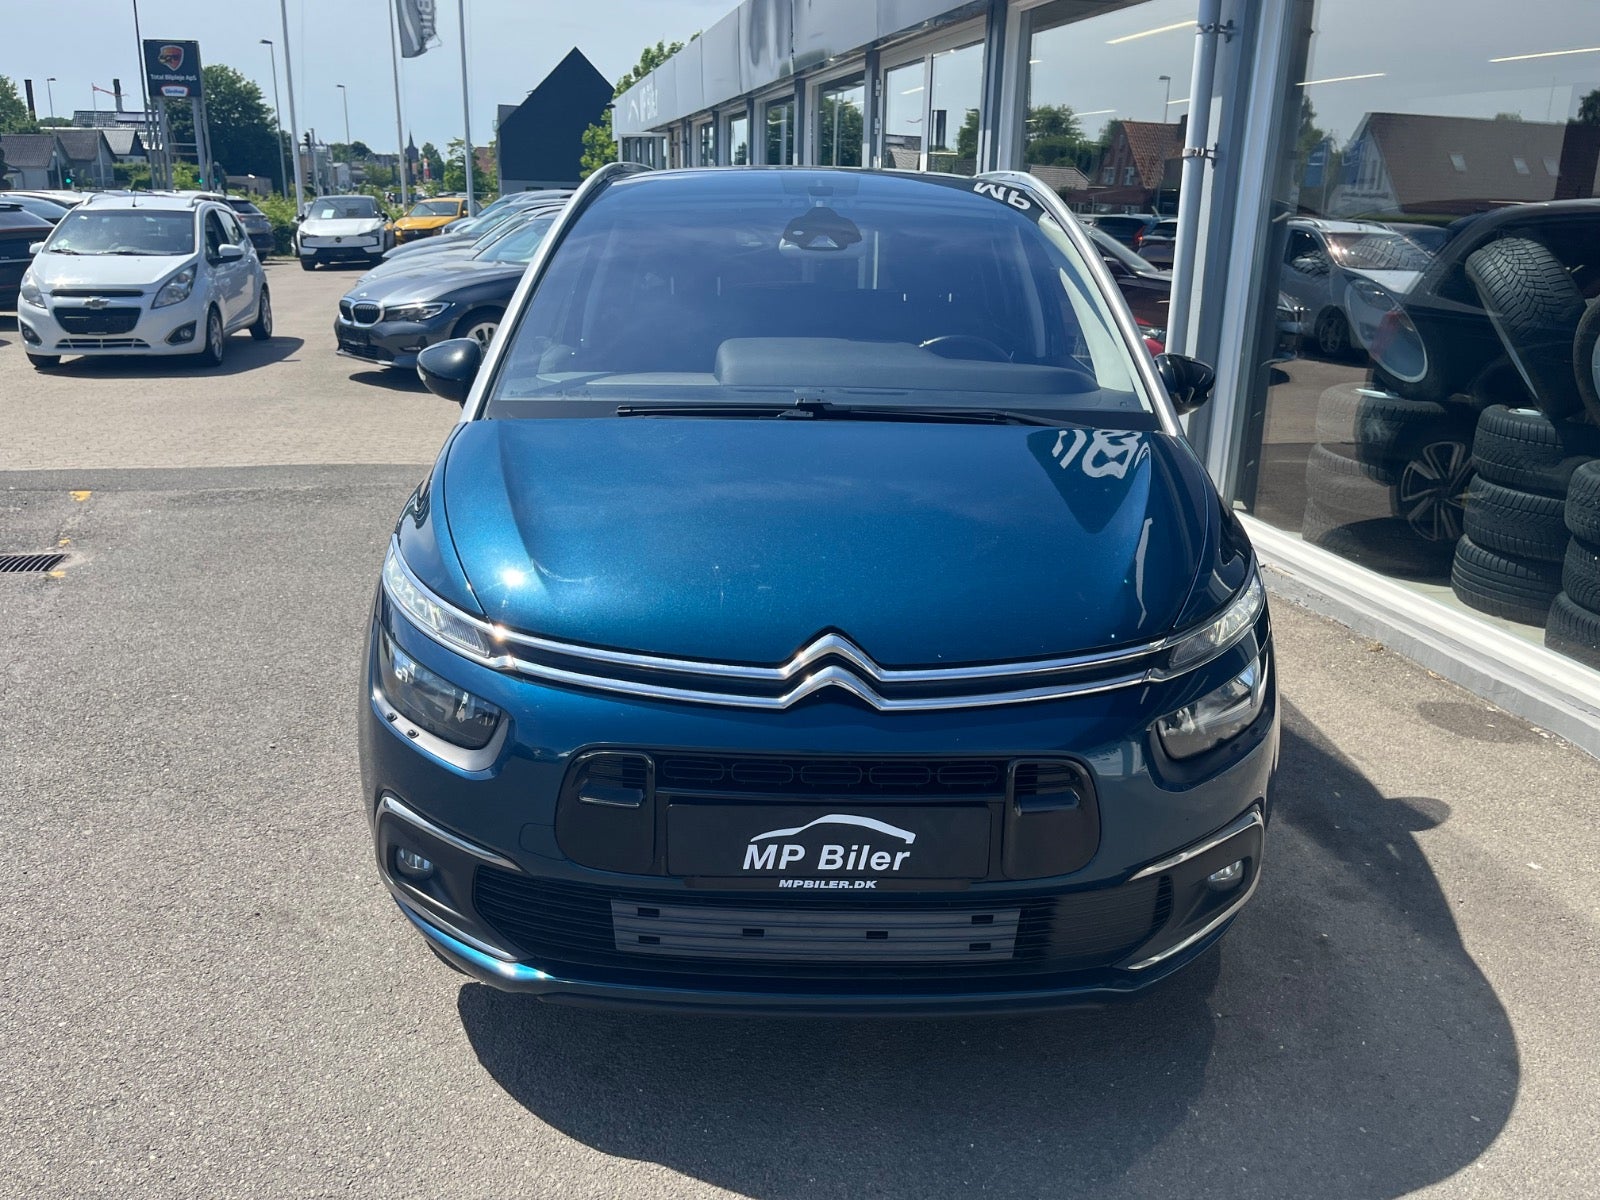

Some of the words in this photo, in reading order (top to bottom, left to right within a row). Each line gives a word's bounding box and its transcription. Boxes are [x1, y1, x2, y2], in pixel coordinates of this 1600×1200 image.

[742, 844, 806, 870] MP
[817, 844, 911, 871] Biler
[778, 879, 878, 889] MPBILER.DK
